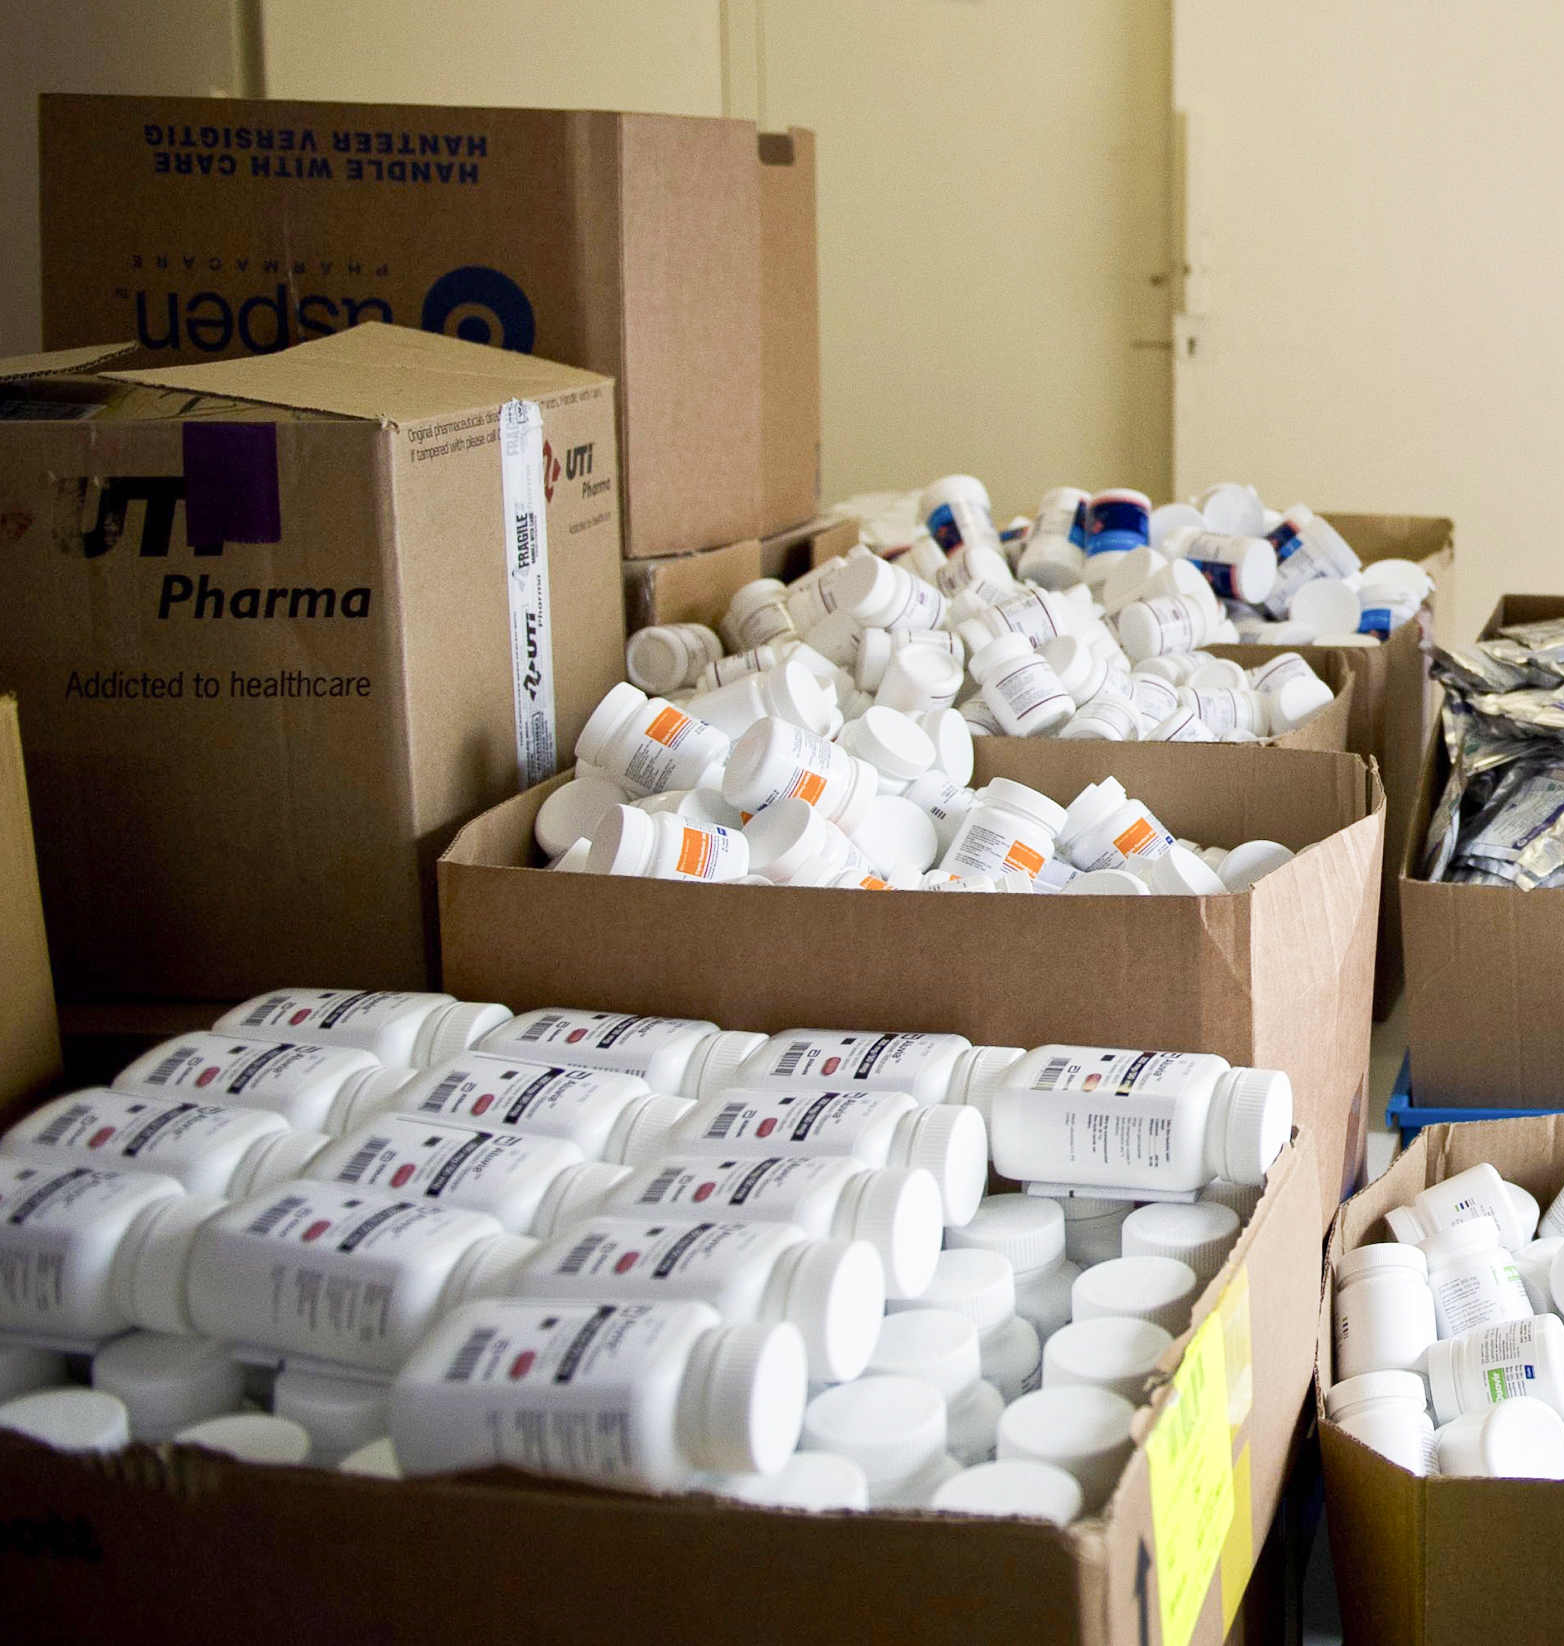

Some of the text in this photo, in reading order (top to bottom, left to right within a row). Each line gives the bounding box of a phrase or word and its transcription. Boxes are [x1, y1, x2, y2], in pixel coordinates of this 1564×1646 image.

[144, 124, 487, 157] HANTEER VERSIGTIG
[154, 152, 480, 184] HANDLE WITH CARE
[131, 254, 390, 278] PHARMACARE
[408, 425, 433, 444] Original
[417, 441, 449, 462] tampered
[450, 437, 466, 453] with
[466, 434, 486, 452] please
[582, 479, 611, 499] Pharma
[517, 513, 530, 569] FRAGILE
[158, 574, 372, 619] Pharma
[66, 670, 372, 699] Addicted to healthcare
[1152, 1058, 1174, 1077] Aluvia
[472, 1146, 504, 1173] Aluvia
